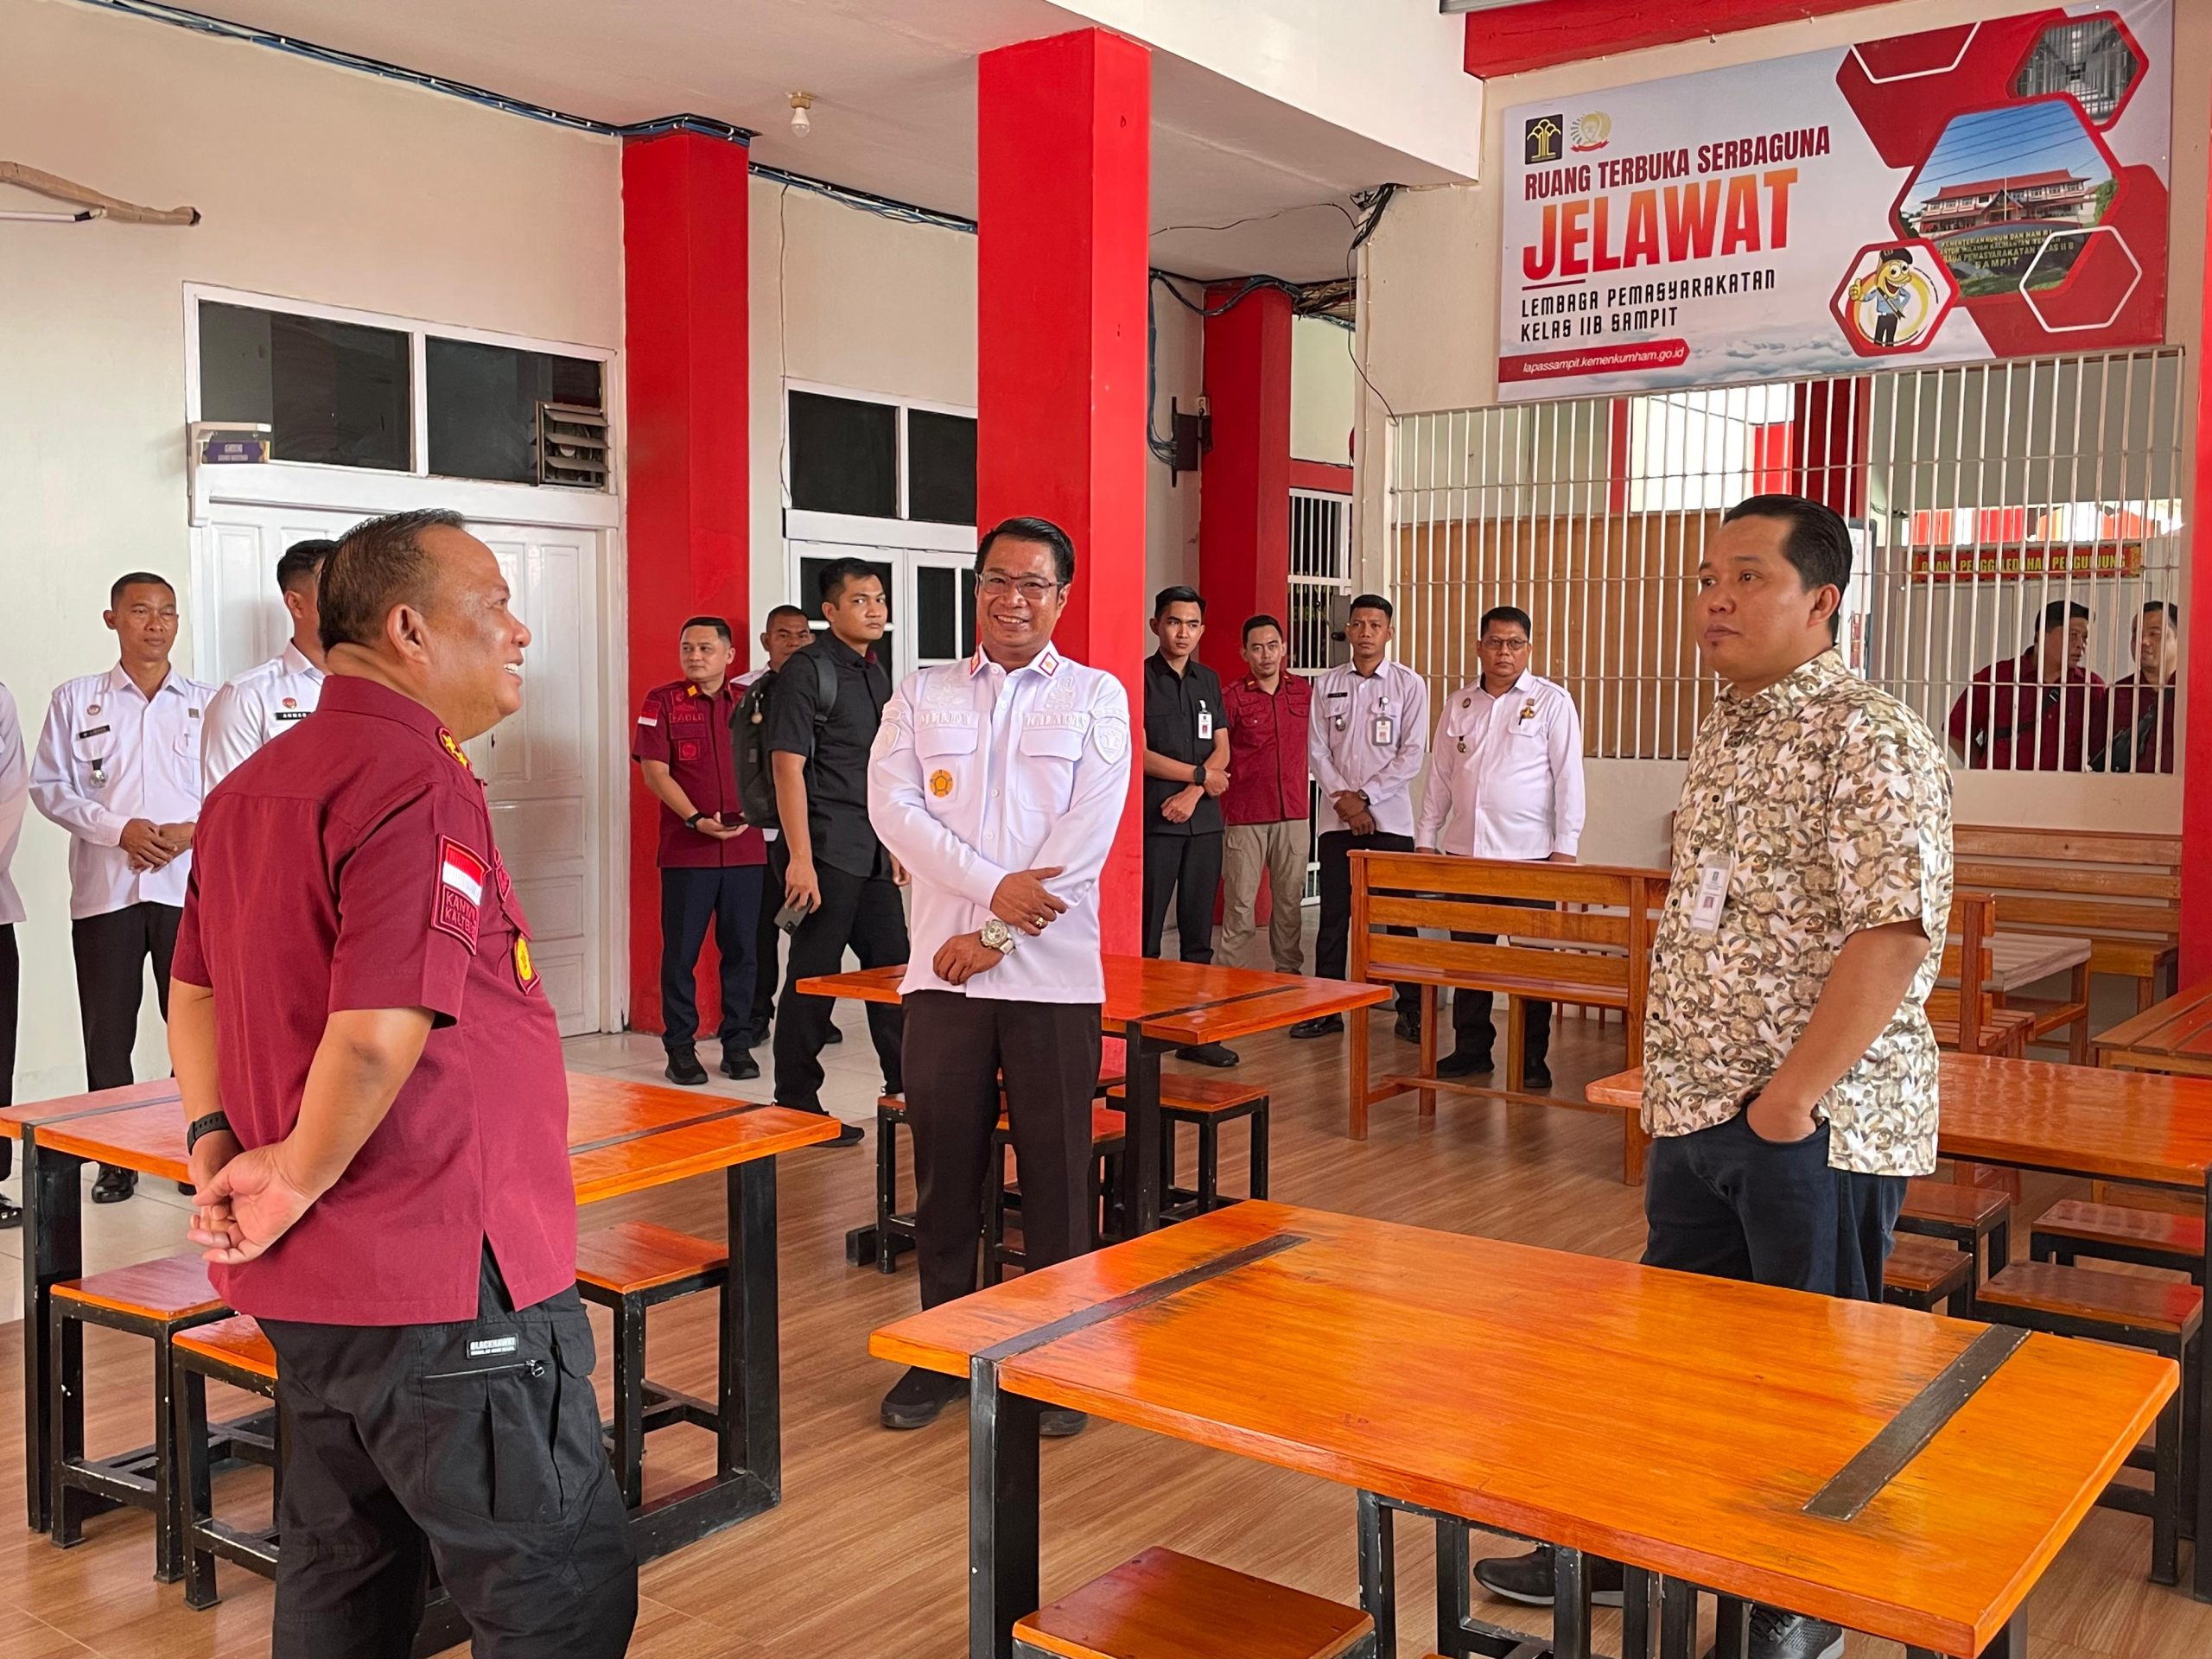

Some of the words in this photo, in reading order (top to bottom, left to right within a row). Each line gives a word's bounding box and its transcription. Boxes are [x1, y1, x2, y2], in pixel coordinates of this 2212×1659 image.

[1525, 164, 1591, 200] RUANG
[1599, 148, 1690, 189] TERBUKA
[1697, 125, 1831, 174] SERBAGUNA
[1522, 167, 1798, 281] JELAWAT
[2010, 231, 2024, 240] DAN
[2025, 230, 2042, 238] HAM
[1939, 246, 1960, 256] ANTOR
[1964, 246, 2035, 263] PEMASYARAKATAN
[1975, 257, 2019, 270] SAMPIT
[1521, 290, 1599, 318] LEMBAGA
[1607, 269, 1775, 308] PEMASYARAKATAN
[1521, 318, 1571, 342] KELAS
[1580, 315, 1602, 336] IIB
[1611, 307, 1678, 333] SAMPIT
[1522, 346, 1684, 374] lapassampit.kemenkumham.go.id
